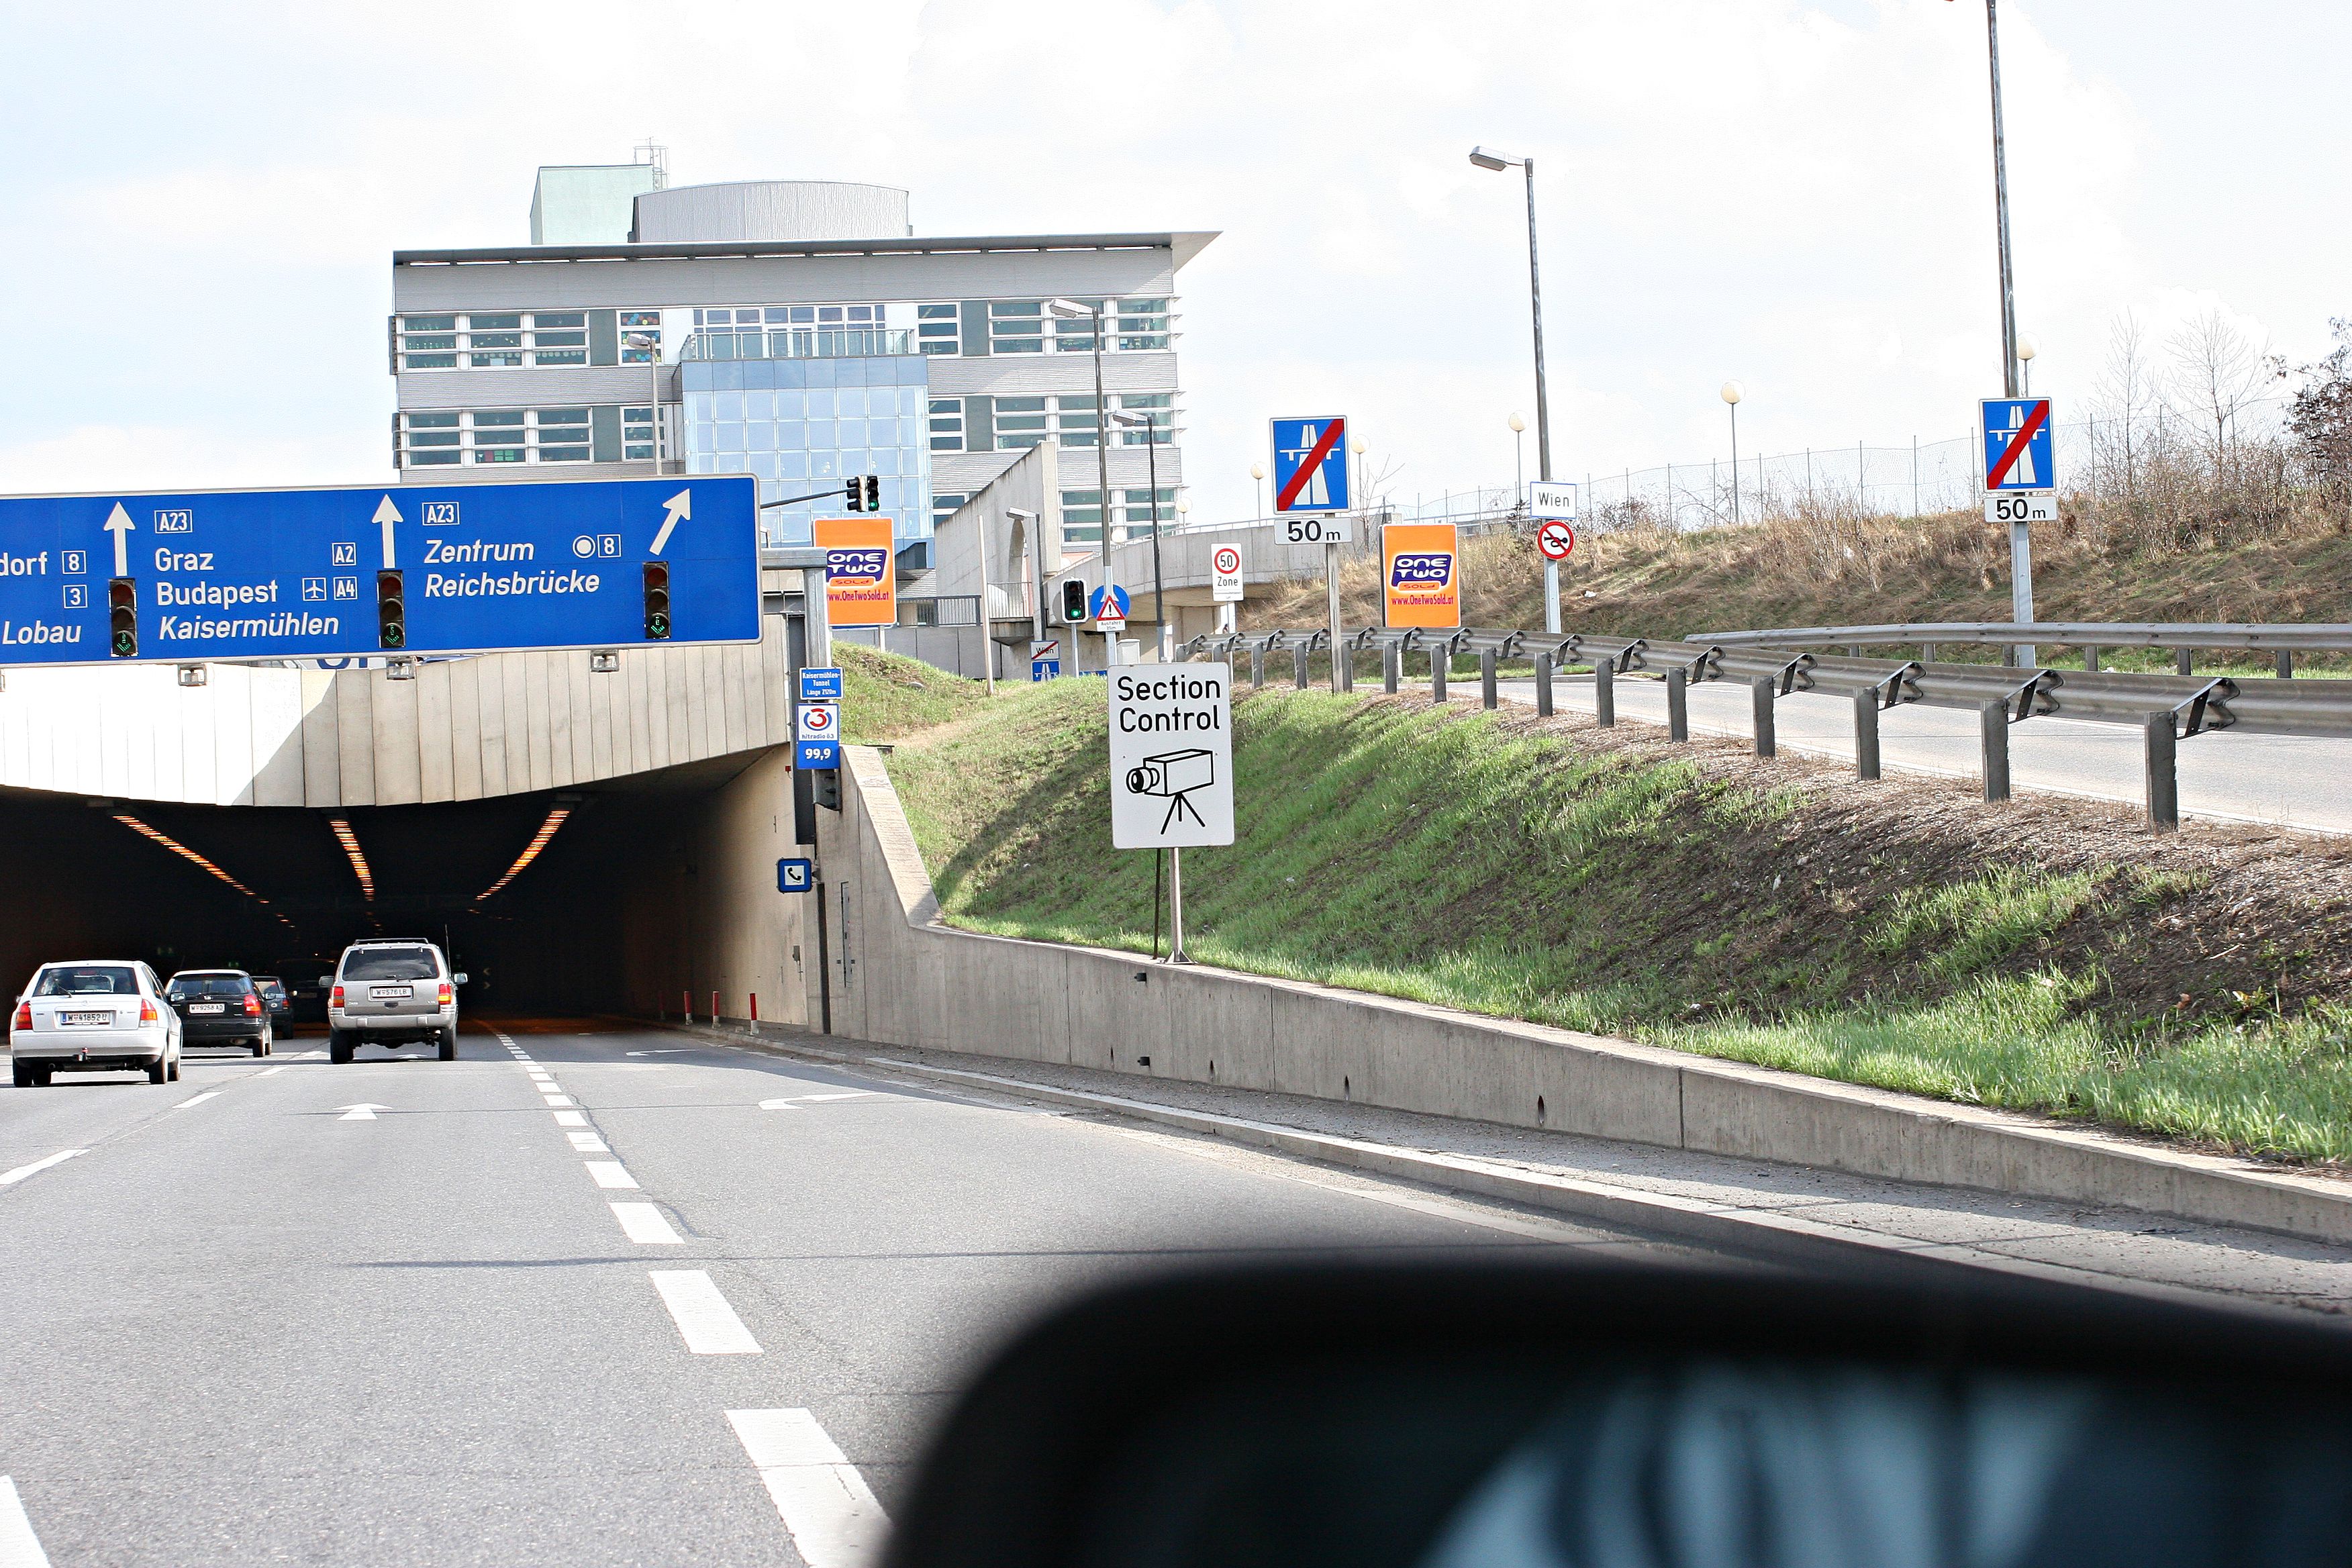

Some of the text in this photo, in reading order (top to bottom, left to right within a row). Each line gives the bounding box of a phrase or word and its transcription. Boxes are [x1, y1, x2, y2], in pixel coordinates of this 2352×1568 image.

[1538, 492, 1569, 507] Wien
[427, 505, 455, 524] A23
[1997, 499, 2046, 520] 50 m
[160, 513, 188, 532] A23
[1287, 520, 1340, 542] 50 m
[335, 546, 354, 563] A2
[424, 539, 534, 564] Zentrum
[604, 537, 615, 555] 8
[68, 554, 80, 571] 8
[155, 547, 214, 572] Graz
[827, 564, 881, 573] TWO
[1220, 554, 1232, 568] 50
[425, 569, 600, 597] Reichsbrücke
[1218, 577, 1238, 586] Zone
[1396, 569, 1446, 579] TWO
[70, 587, 81, 605] 3
[157, 579, 279, 610] Budapest
[336, 579, 355, 597] A4
[826, 589, 889, 601] ww.OneTwoSold.at
[2, 620, 82, 645] Lobau
[159, 611, 338, 640] Kaisermühlen
[1118, 675, 1220, 701] Section
[1120, 705, 1220, 732] Control
[805, 748, 832, 761] 99,9
